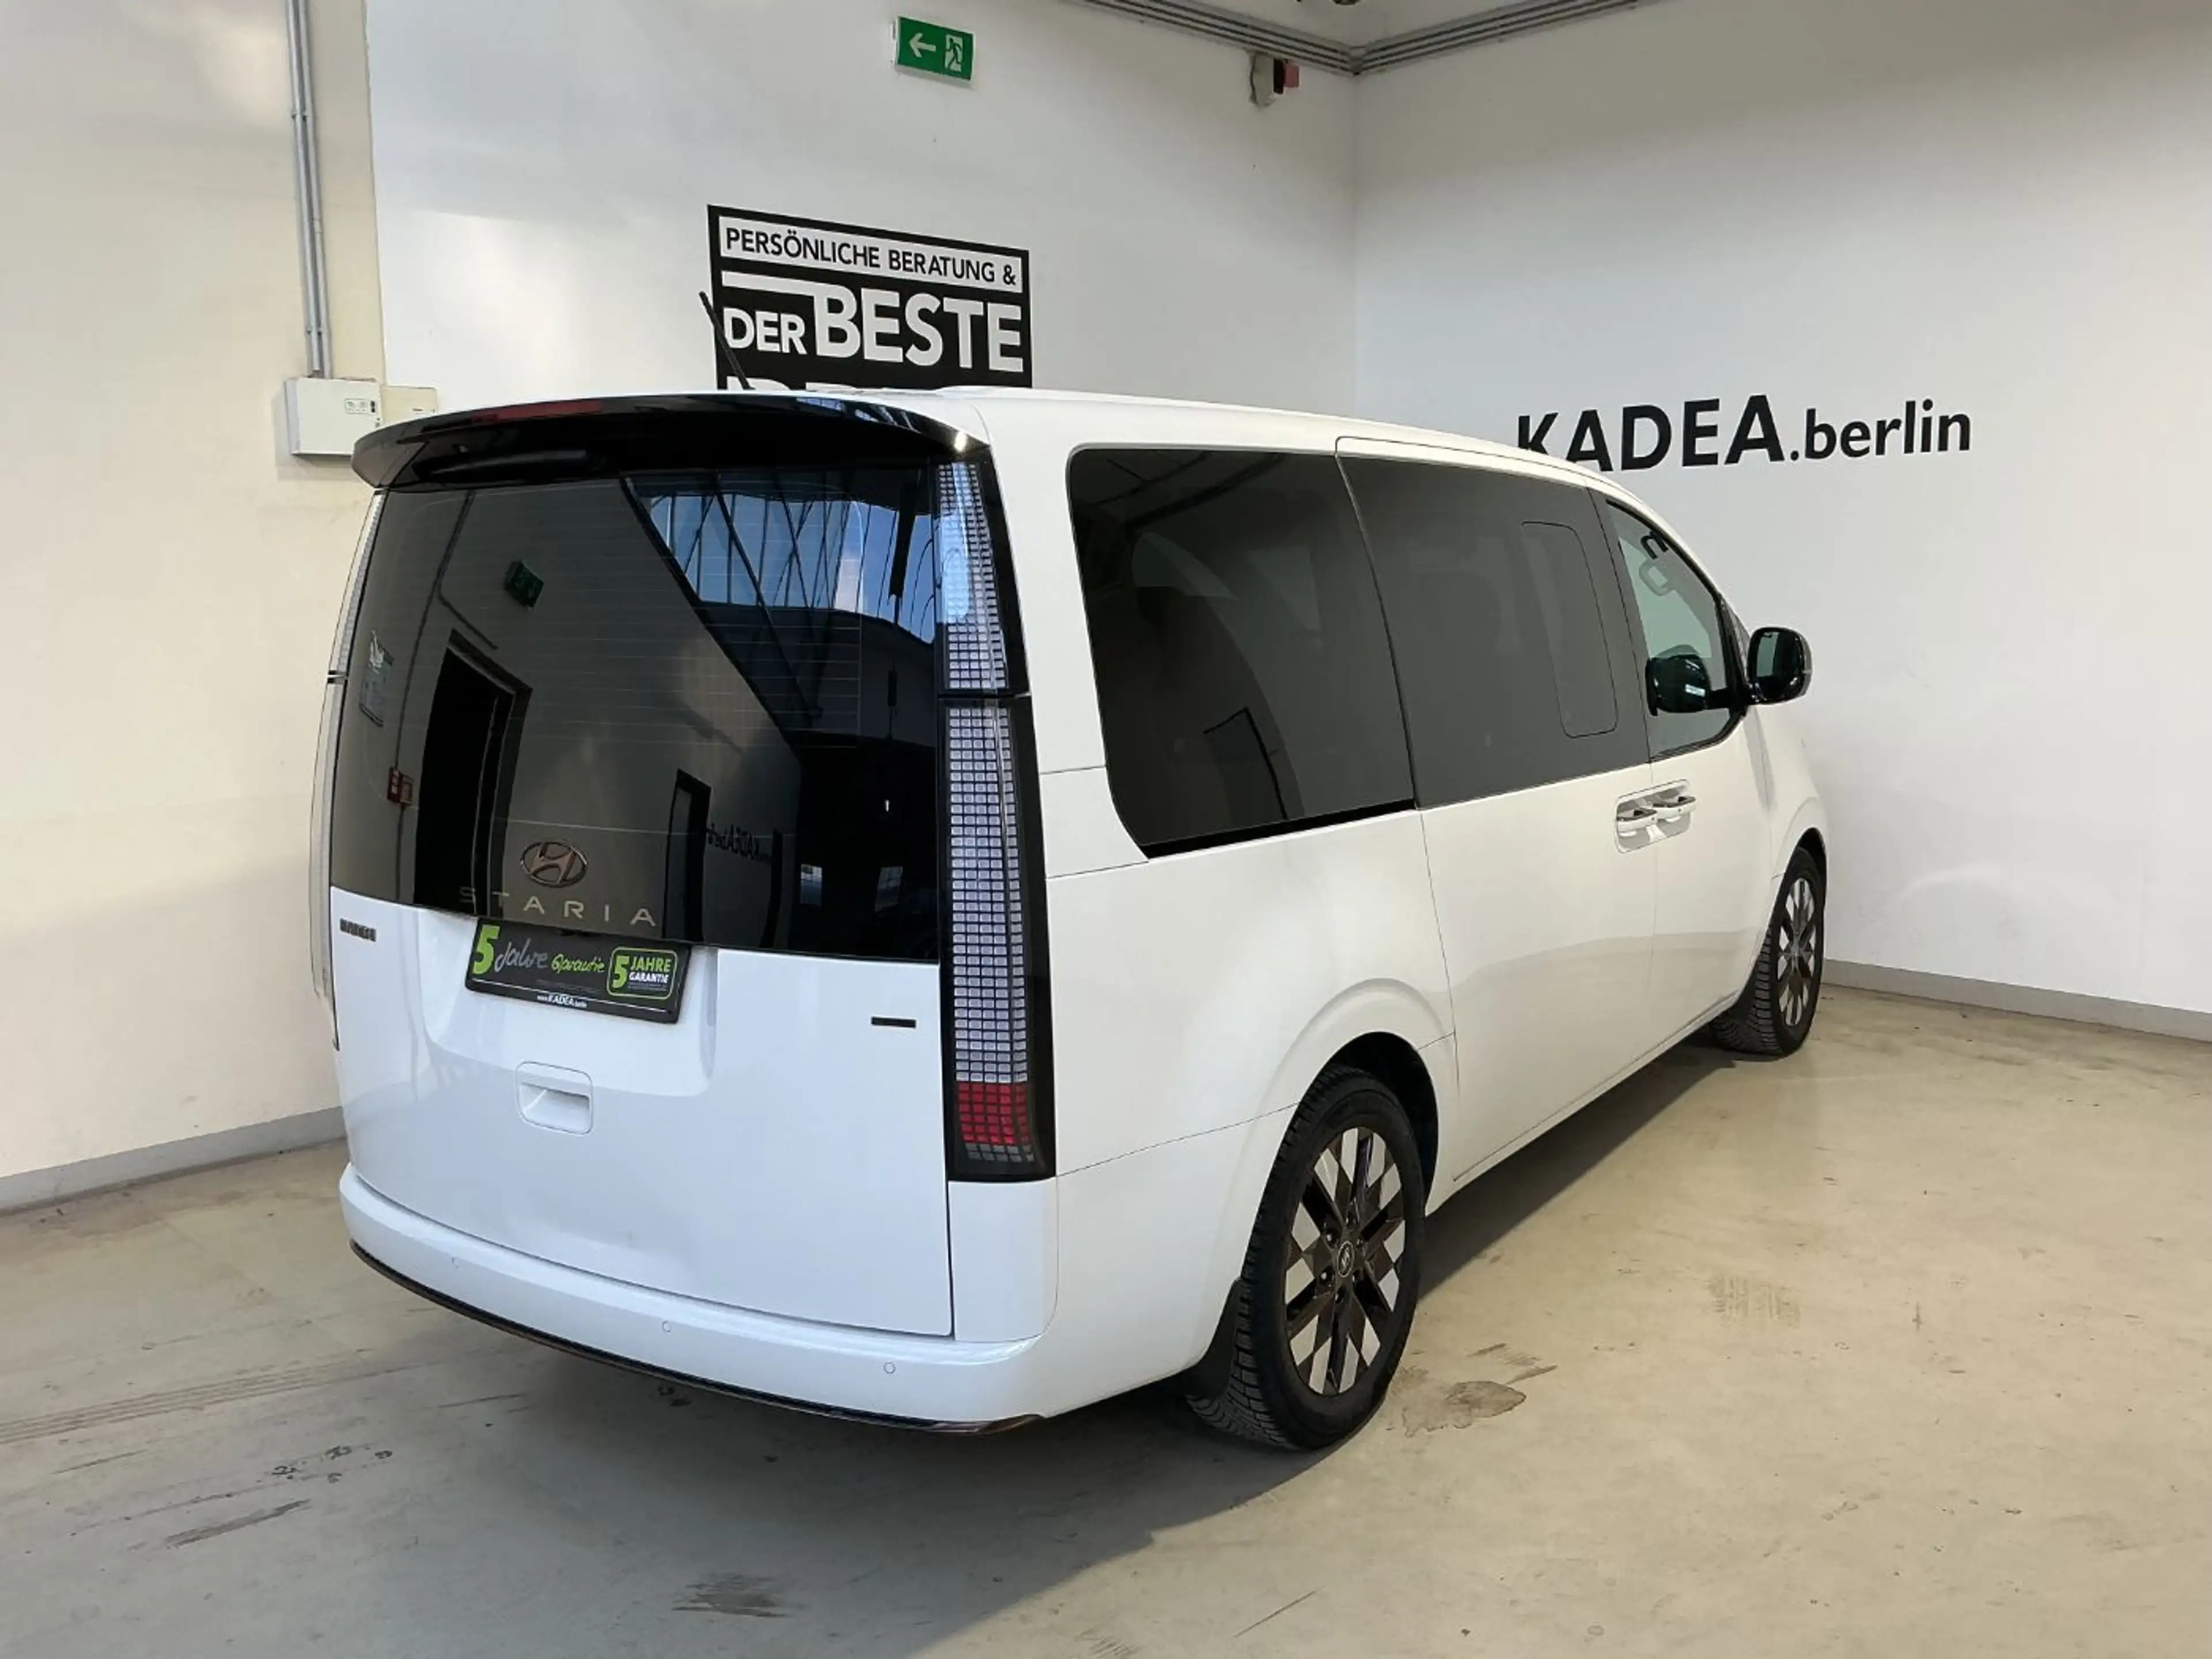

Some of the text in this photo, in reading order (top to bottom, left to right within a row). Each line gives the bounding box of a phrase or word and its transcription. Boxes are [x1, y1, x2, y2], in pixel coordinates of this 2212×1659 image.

[726, 227, 1017, 285] PERSÖNLICHE BERATUNG &
[723, 286, 1024, 372] DER BESTE
[1518, 395, 1971, 472] KADEA.berlin
[459, 886, 656, 927] STARIA
[472, 924, 501, 975] 5
[612, 955, 630, 988] 5
[630, 956, 672, 972] JAHRE
